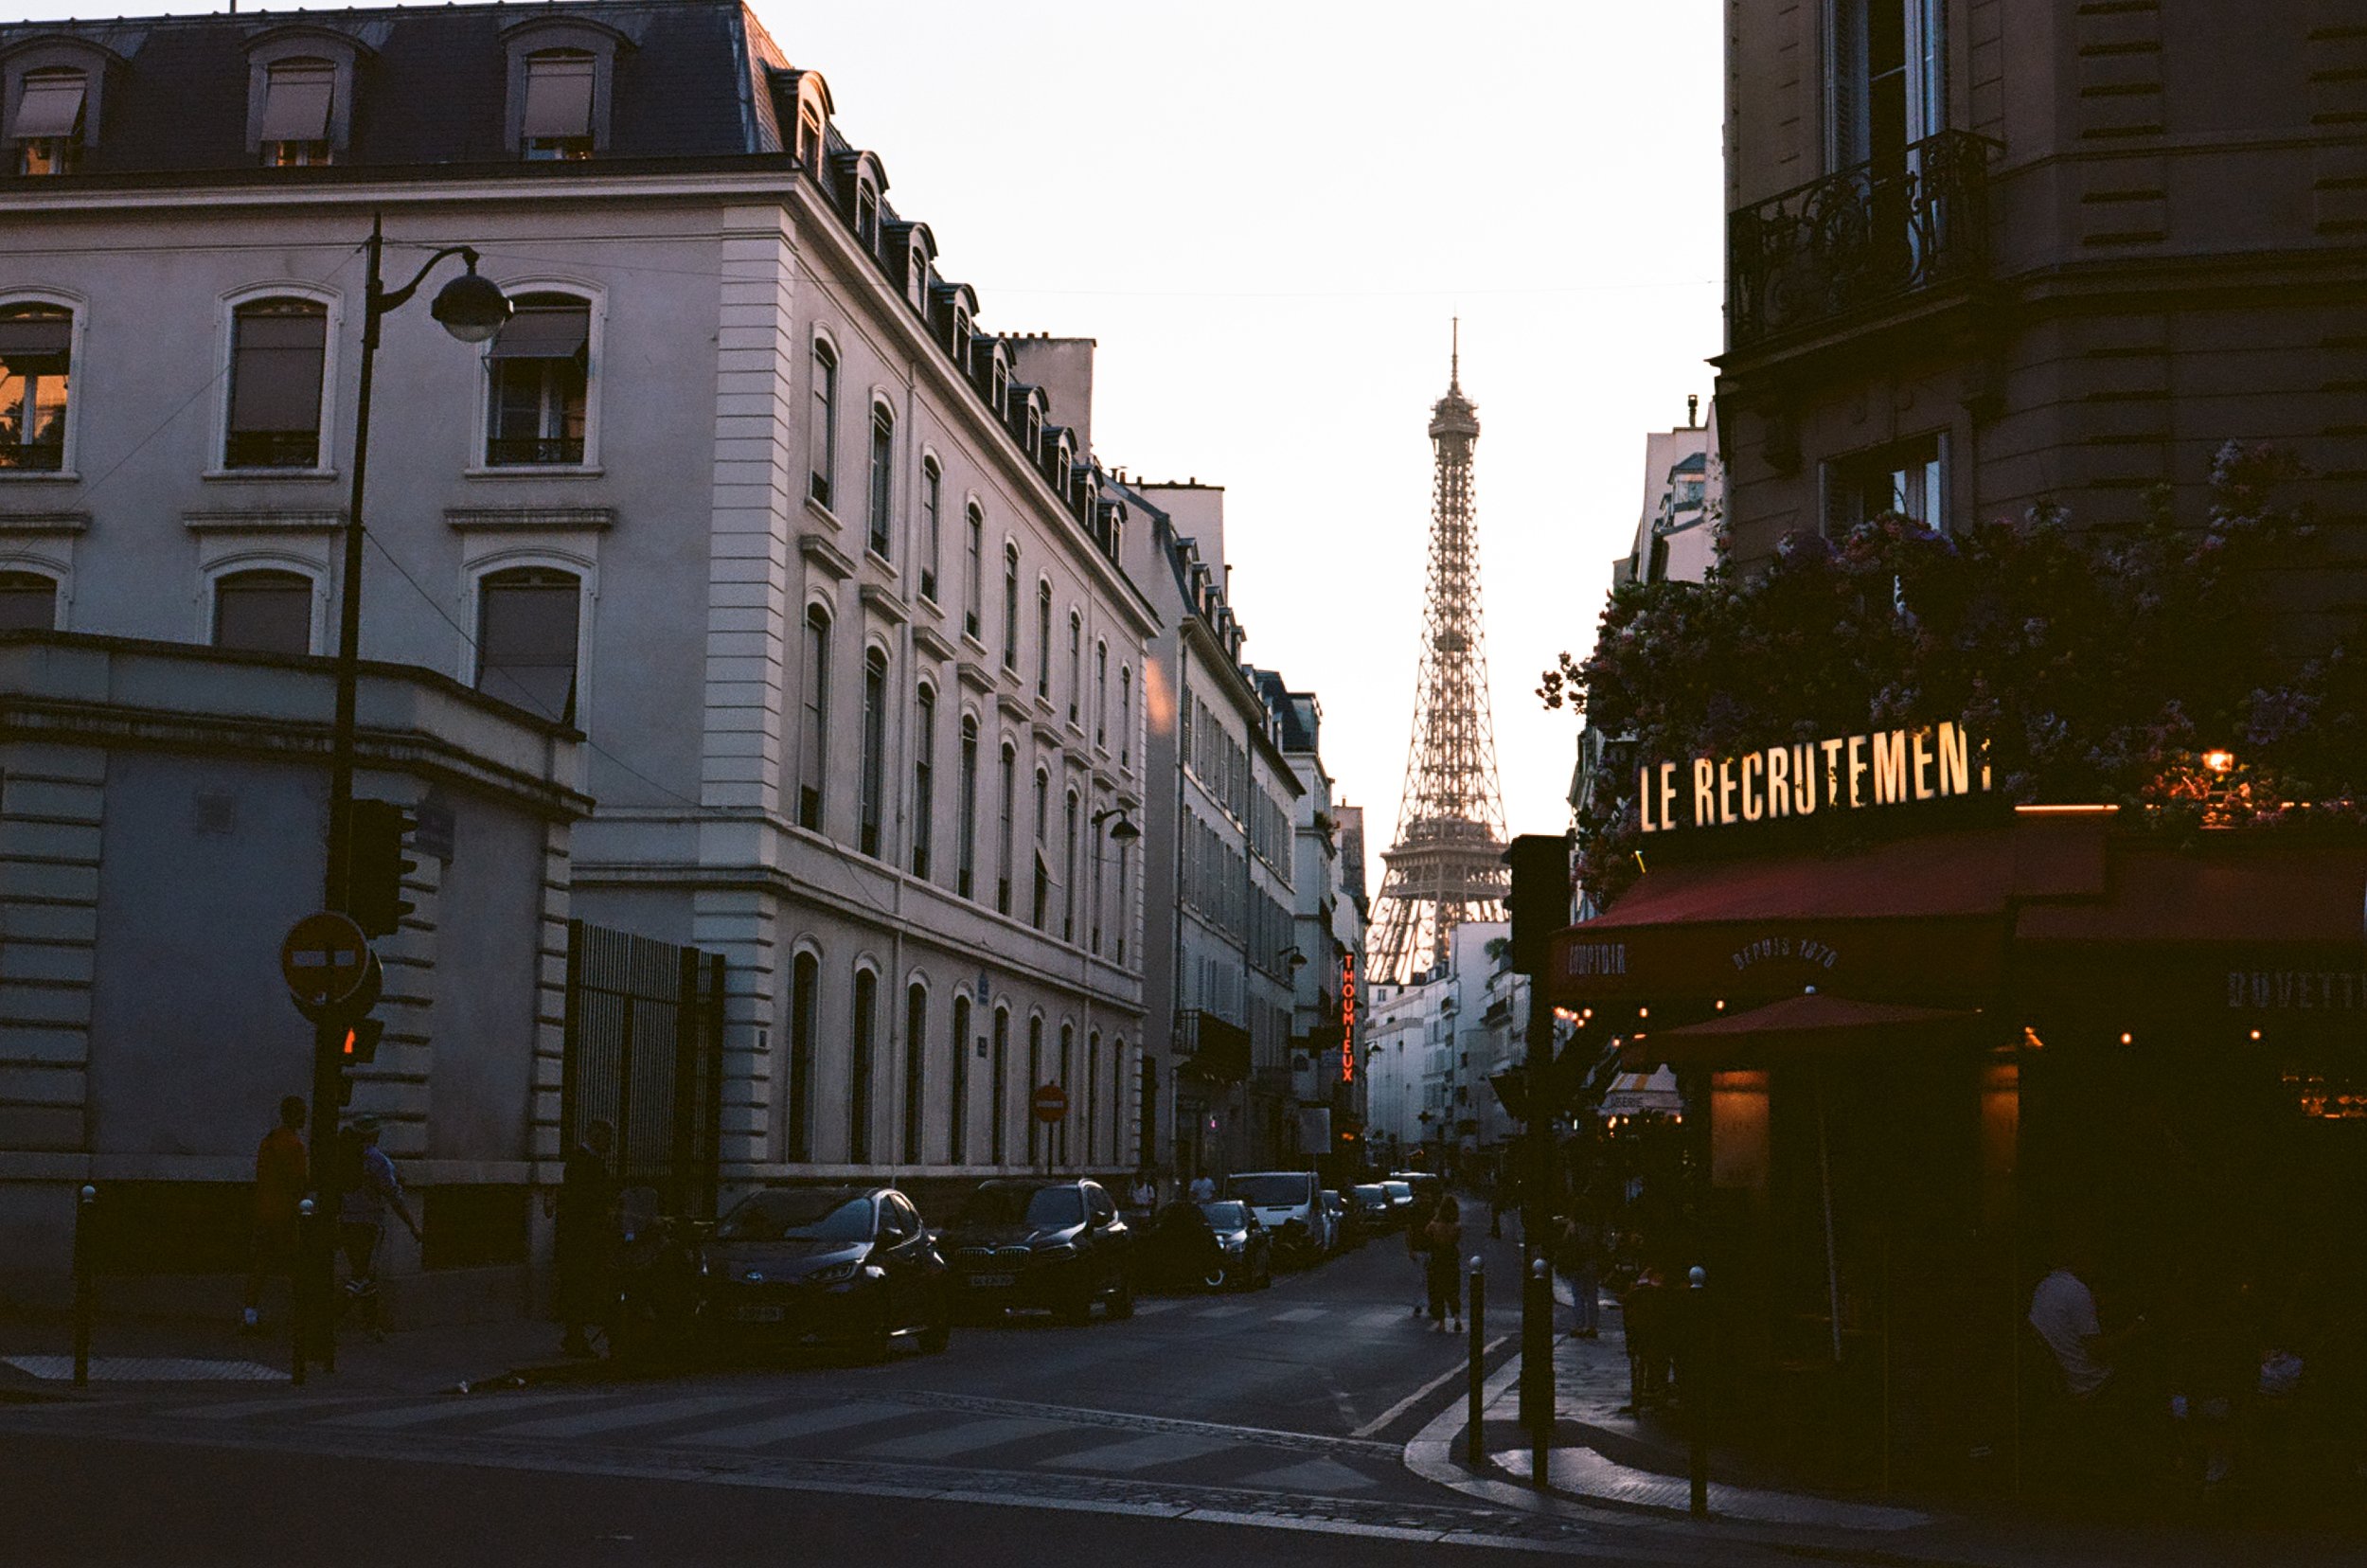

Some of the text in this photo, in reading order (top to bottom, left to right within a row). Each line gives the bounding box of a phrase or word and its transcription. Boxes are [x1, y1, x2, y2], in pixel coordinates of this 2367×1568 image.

[1640, 761, 1677, 832] LE
[1568, 943, 1627, 975] COMPTOIR
[1732, 936, 1790, 971] DEPUIS
[1342, 954, 1355, 1082] THOUMIEUX
